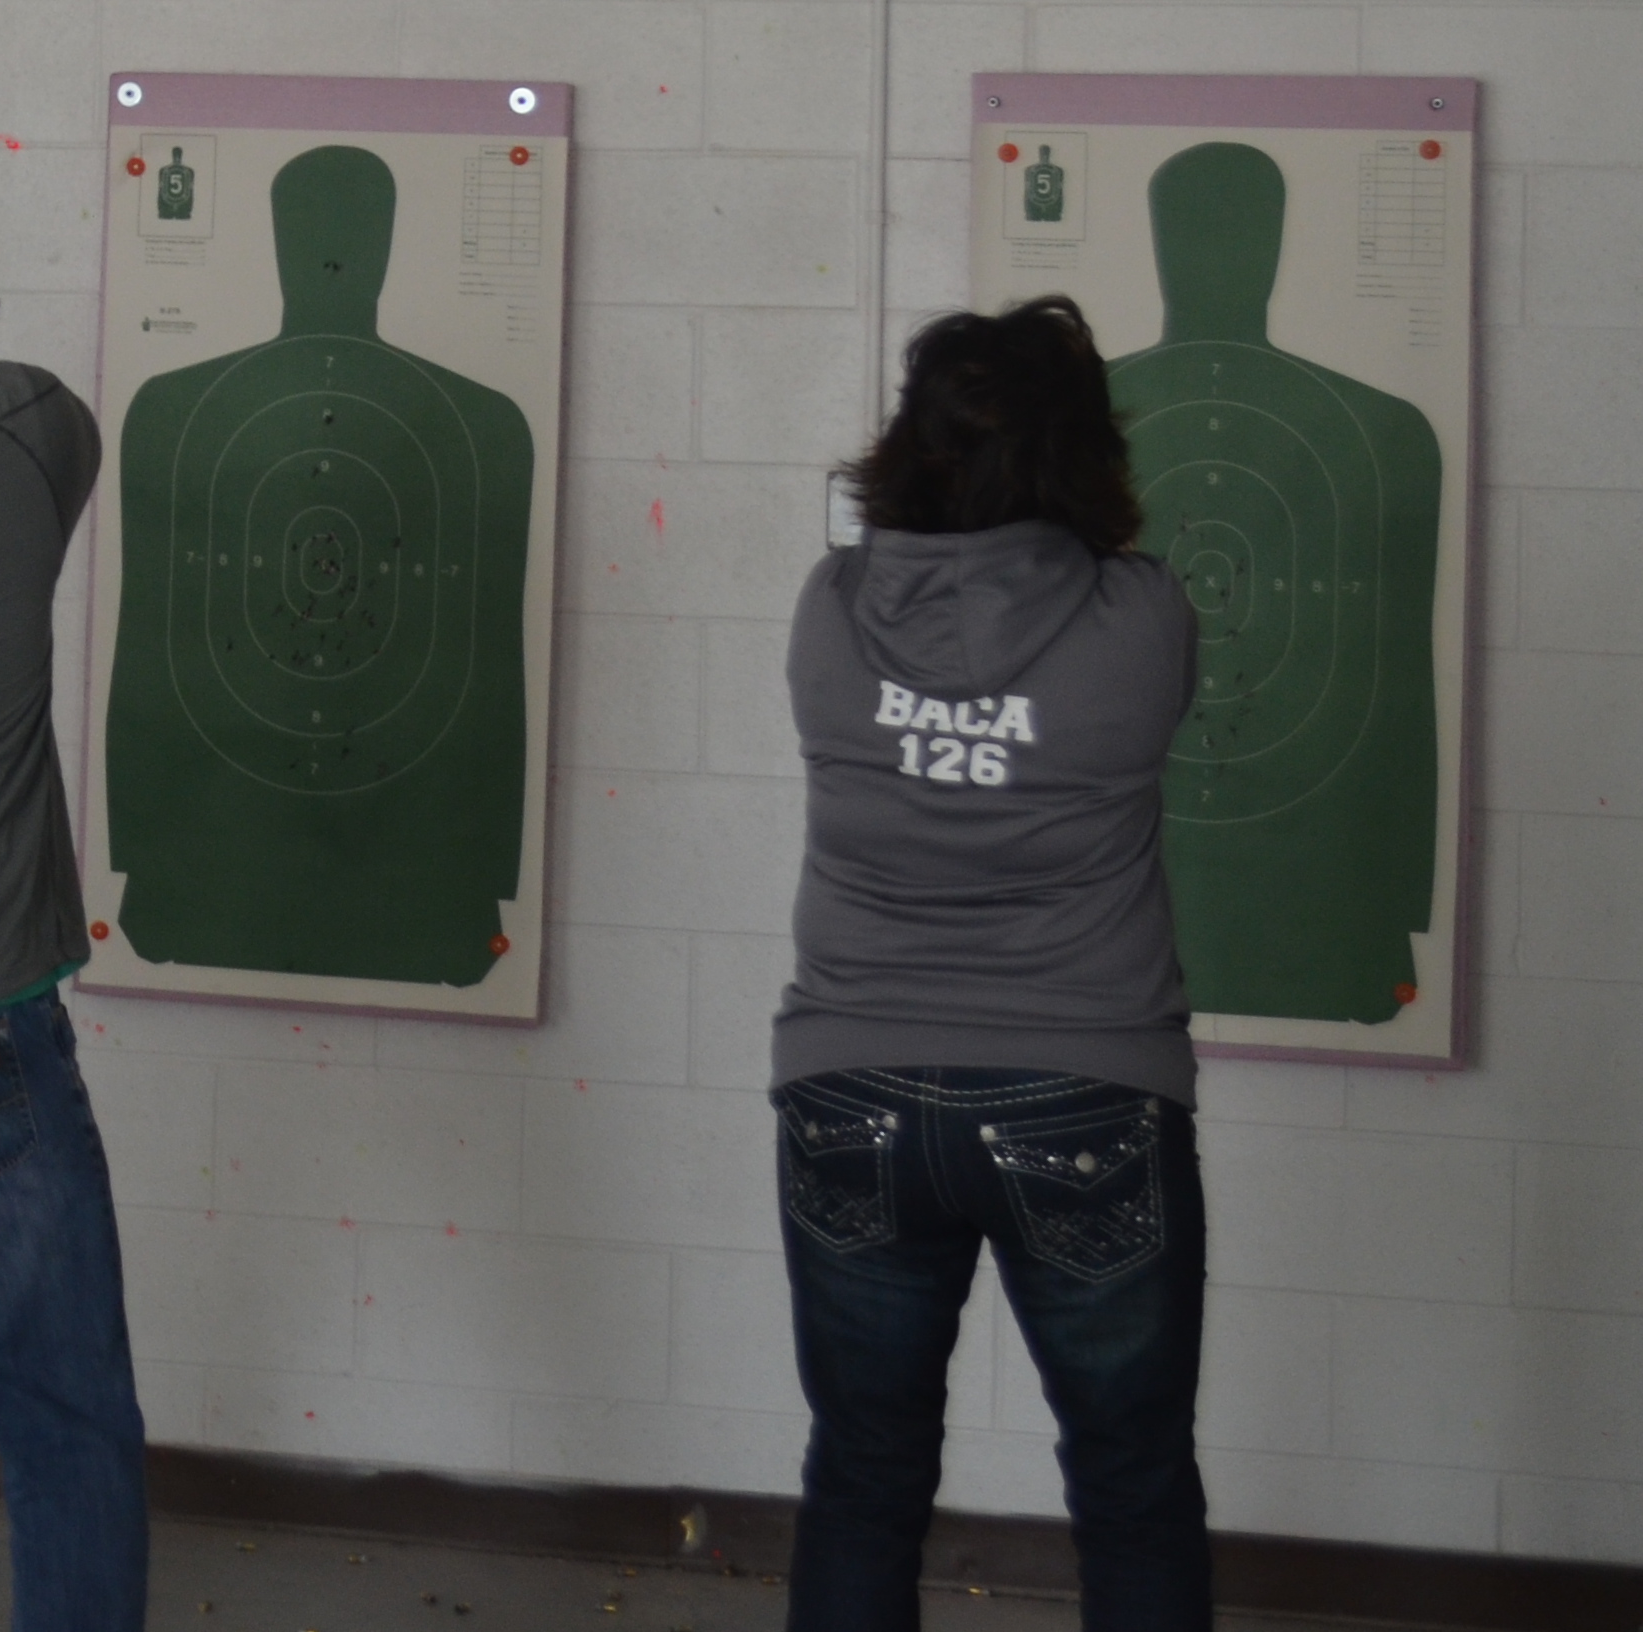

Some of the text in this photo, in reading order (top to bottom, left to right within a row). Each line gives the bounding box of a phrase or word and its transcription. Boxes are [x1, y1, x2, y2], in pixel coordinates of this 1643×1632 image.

[170, 174, 183, 194] 5
[1037, 173, 1051, 194] 5
[326, 355, 335, 369] 7
[1211, 362, 1221, 376] 7
[874, 679, 1037, 743] BACA
[898, 733, 1009, 787] 126
